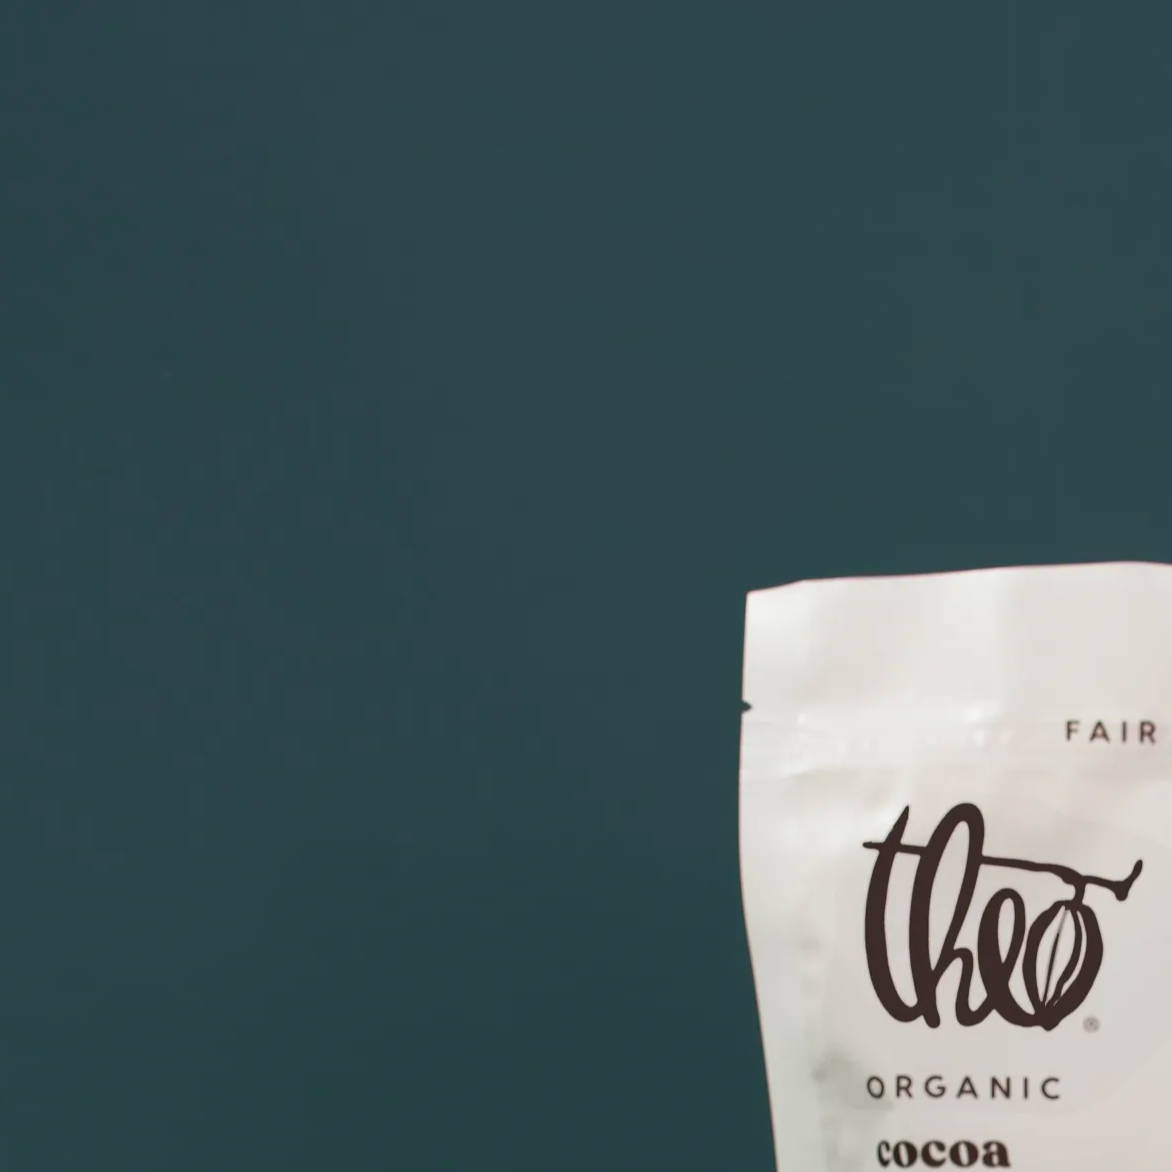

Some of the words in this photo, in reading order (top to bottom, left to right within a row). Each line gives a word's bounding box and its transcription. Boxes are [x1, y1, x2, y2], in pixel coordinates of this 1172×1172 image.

[1066, 721, 1156, 745] FAIR
[863, 803, 1143, 1031] theo
[866, 1075, 1064, 1100] ORGANIC
[877, 1140, 1011, 1168] cocoa
